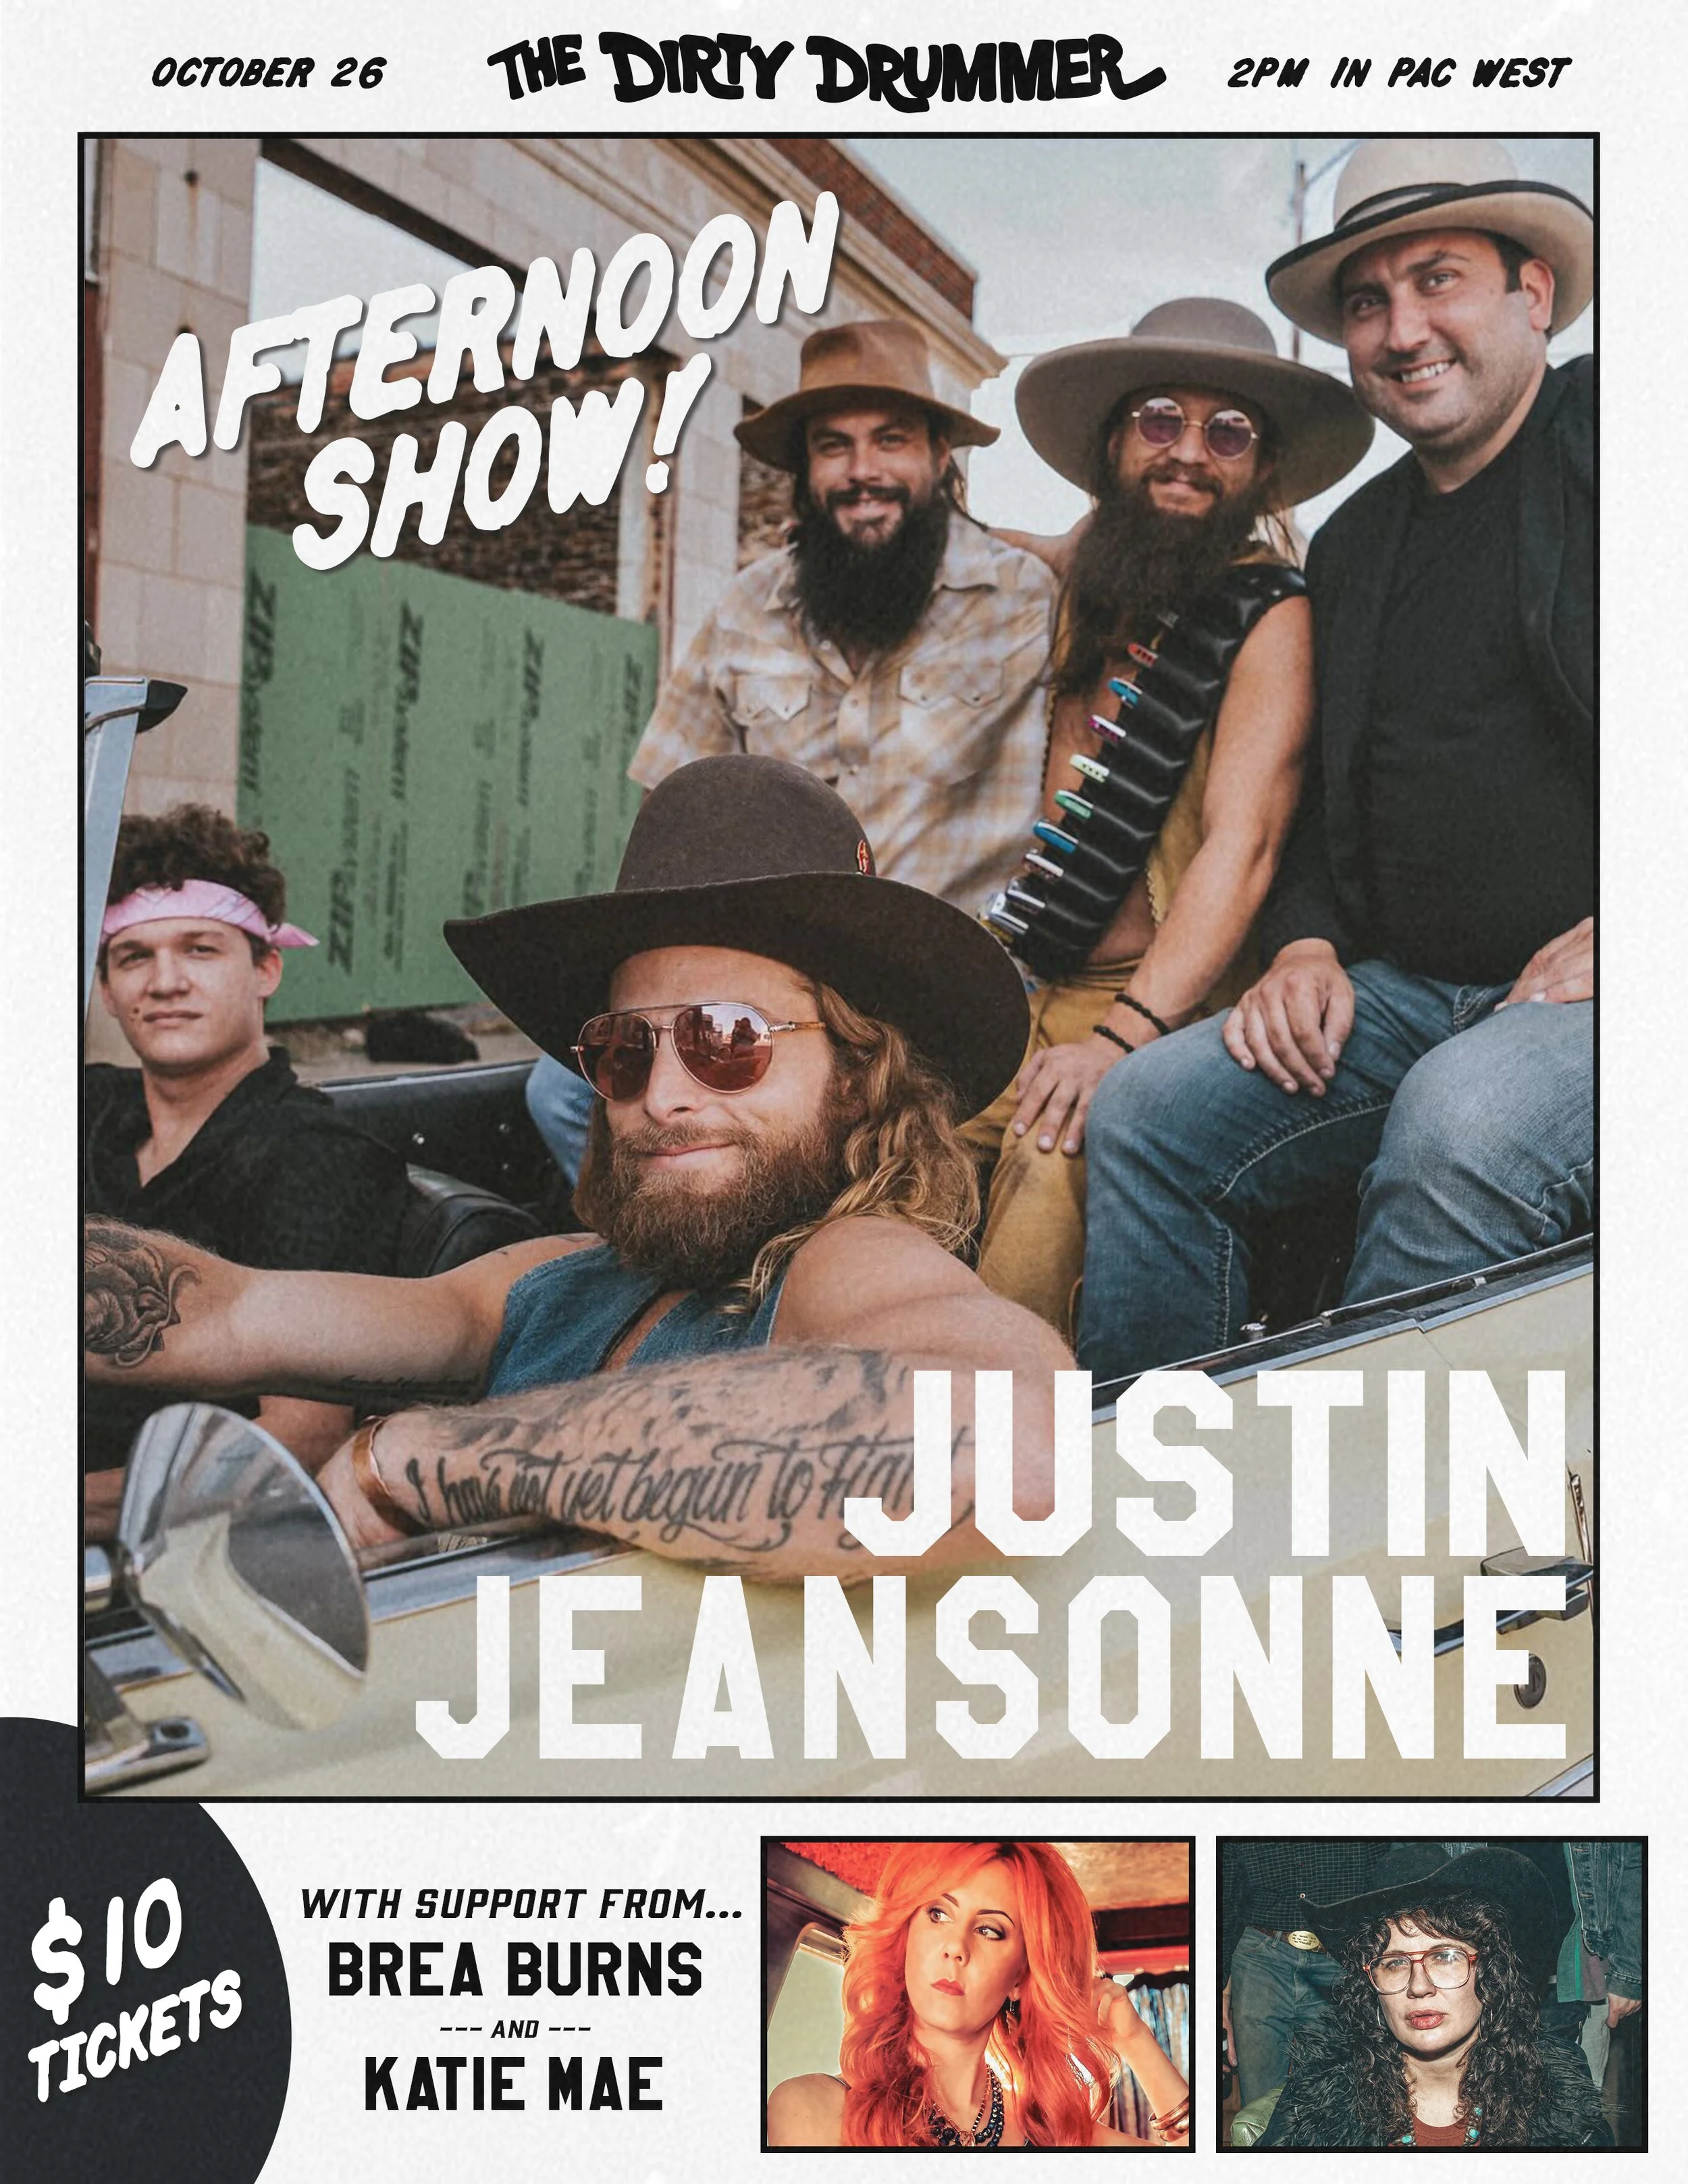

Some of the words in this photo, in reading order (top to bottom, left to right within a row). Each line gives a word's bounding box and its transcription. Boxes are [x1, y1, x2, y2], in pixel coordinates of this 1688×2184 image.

[151, 57, 315, 88] OCTOBER
[330, 56, 388, 88] 26
[487, 34, 587, 101] THE
[598, 31, 795, 103] DIRTY
[806, 33, 1167, 113] DRUMMER
[1227, 57, 1310, 88] 2PM
[1330, 56, 1372, 88] IN
[1388, 57, 1457, 88] PAC
[1472, 57, 1573, 88] WEST
[130, 191, 839, 468] AFTERNOON
[292, 352, 712, 570] SHOW!
[405, 1457, 431, 1522] I
[437, 1456, 502, 1526] have
[562, 1448, 643, 1524] yet
[621, 1447, 776, 1547] begun
[755, 1438, 814, 1520] to
[844, 1370, 1566, 1557] JUSTIN
[415, 1575, 1566, 1759] JEANSONNE
[31, 1877, 182, 2025] $10
[301, 1888, 402, 1919] WITH
[415, 1888, 587, 1919] SUPPORT
[599, 1888, 742, 1919] FROM...
[329, 1942, 483, 1996] BREA
[507, 1942, 702, 1996] BURNS
[28, 1969, 242, 2103] TICKETS
[490, 2020, 539, 2039] AND
[365, 2056, 525, 2110] KATIE
[548, 2056, 663, 2110] MAE
